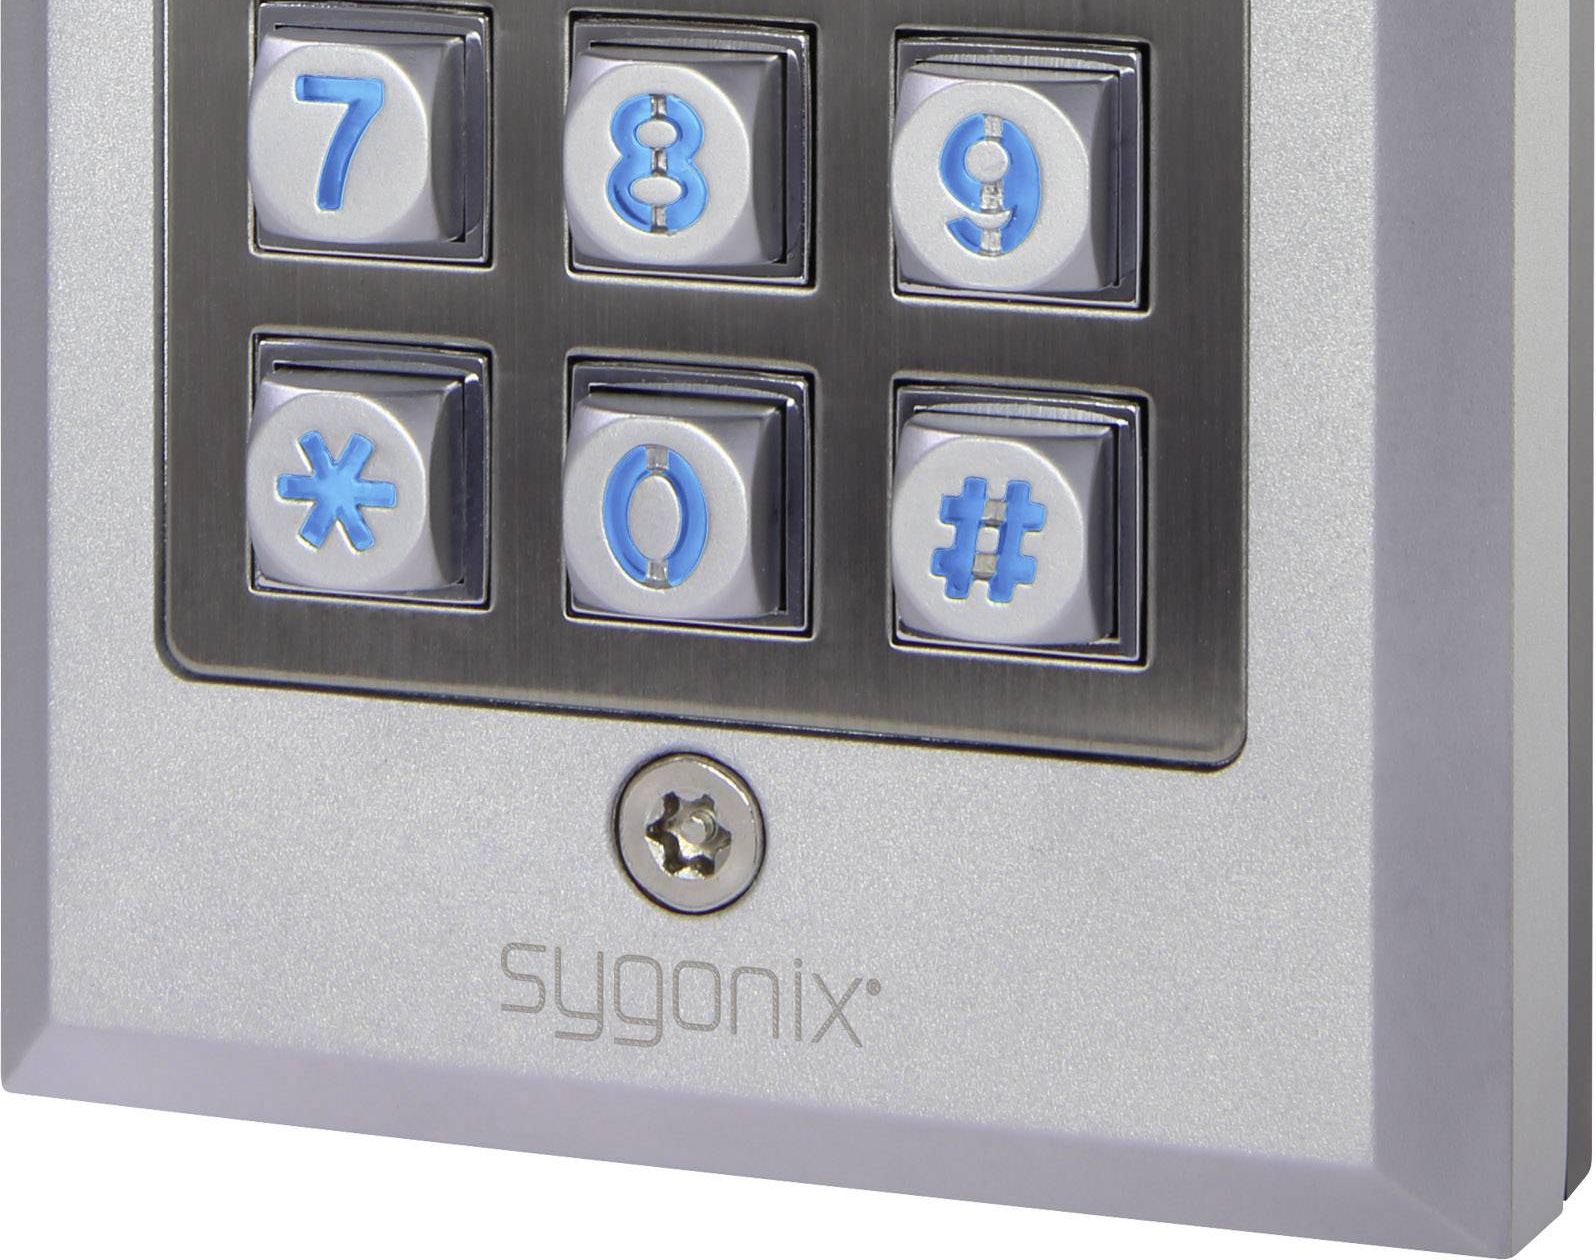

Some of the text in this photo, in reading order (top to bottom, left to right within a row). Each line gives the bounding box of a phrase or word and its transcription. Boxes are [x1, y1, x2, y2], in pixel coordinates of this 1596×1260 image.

[296, 75, 385, 210] 7
[608, 94, 708, 231] 8
[940, 115, 1041, 253] 9
[604, 445, 708, 585] 0
[932, 477, 1045, 603] #
